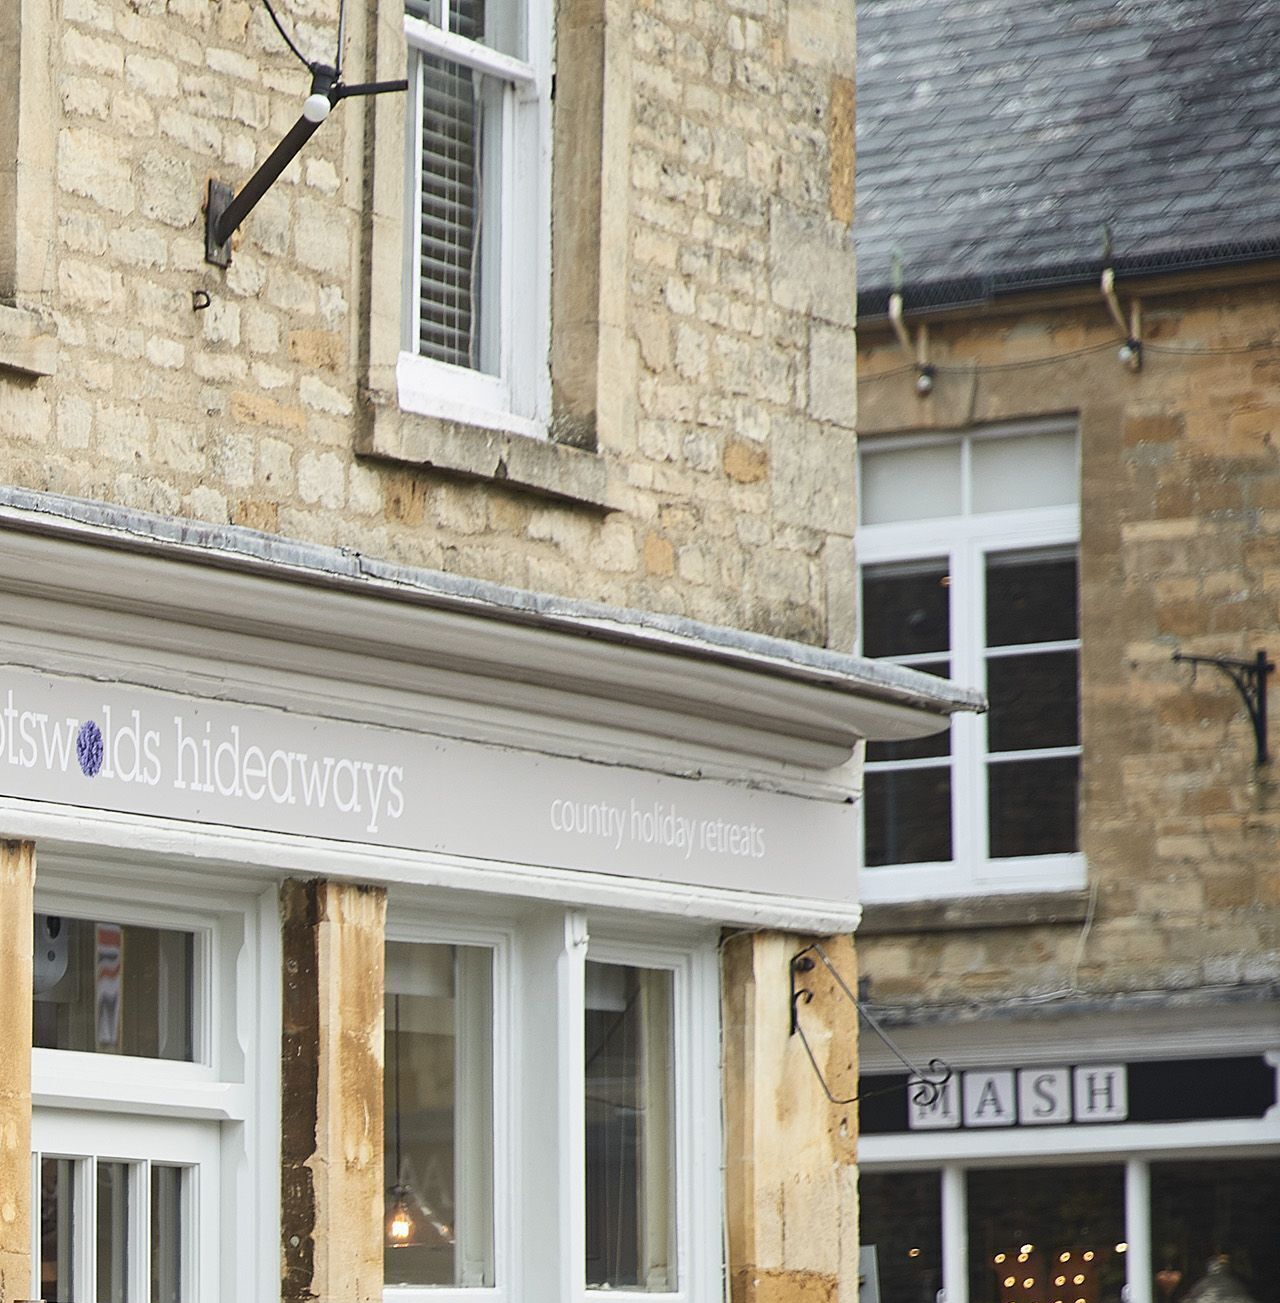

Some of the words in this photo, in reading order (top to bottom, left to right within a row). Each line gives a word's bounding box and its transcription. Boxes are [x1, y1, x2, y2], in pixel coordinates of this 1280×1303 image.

[174, 716, 405, 832] hideaways
[550, 798, 626, 845] country
[630, 798, 695, 859] holiday
[699, 819, 766, 859] retreats
